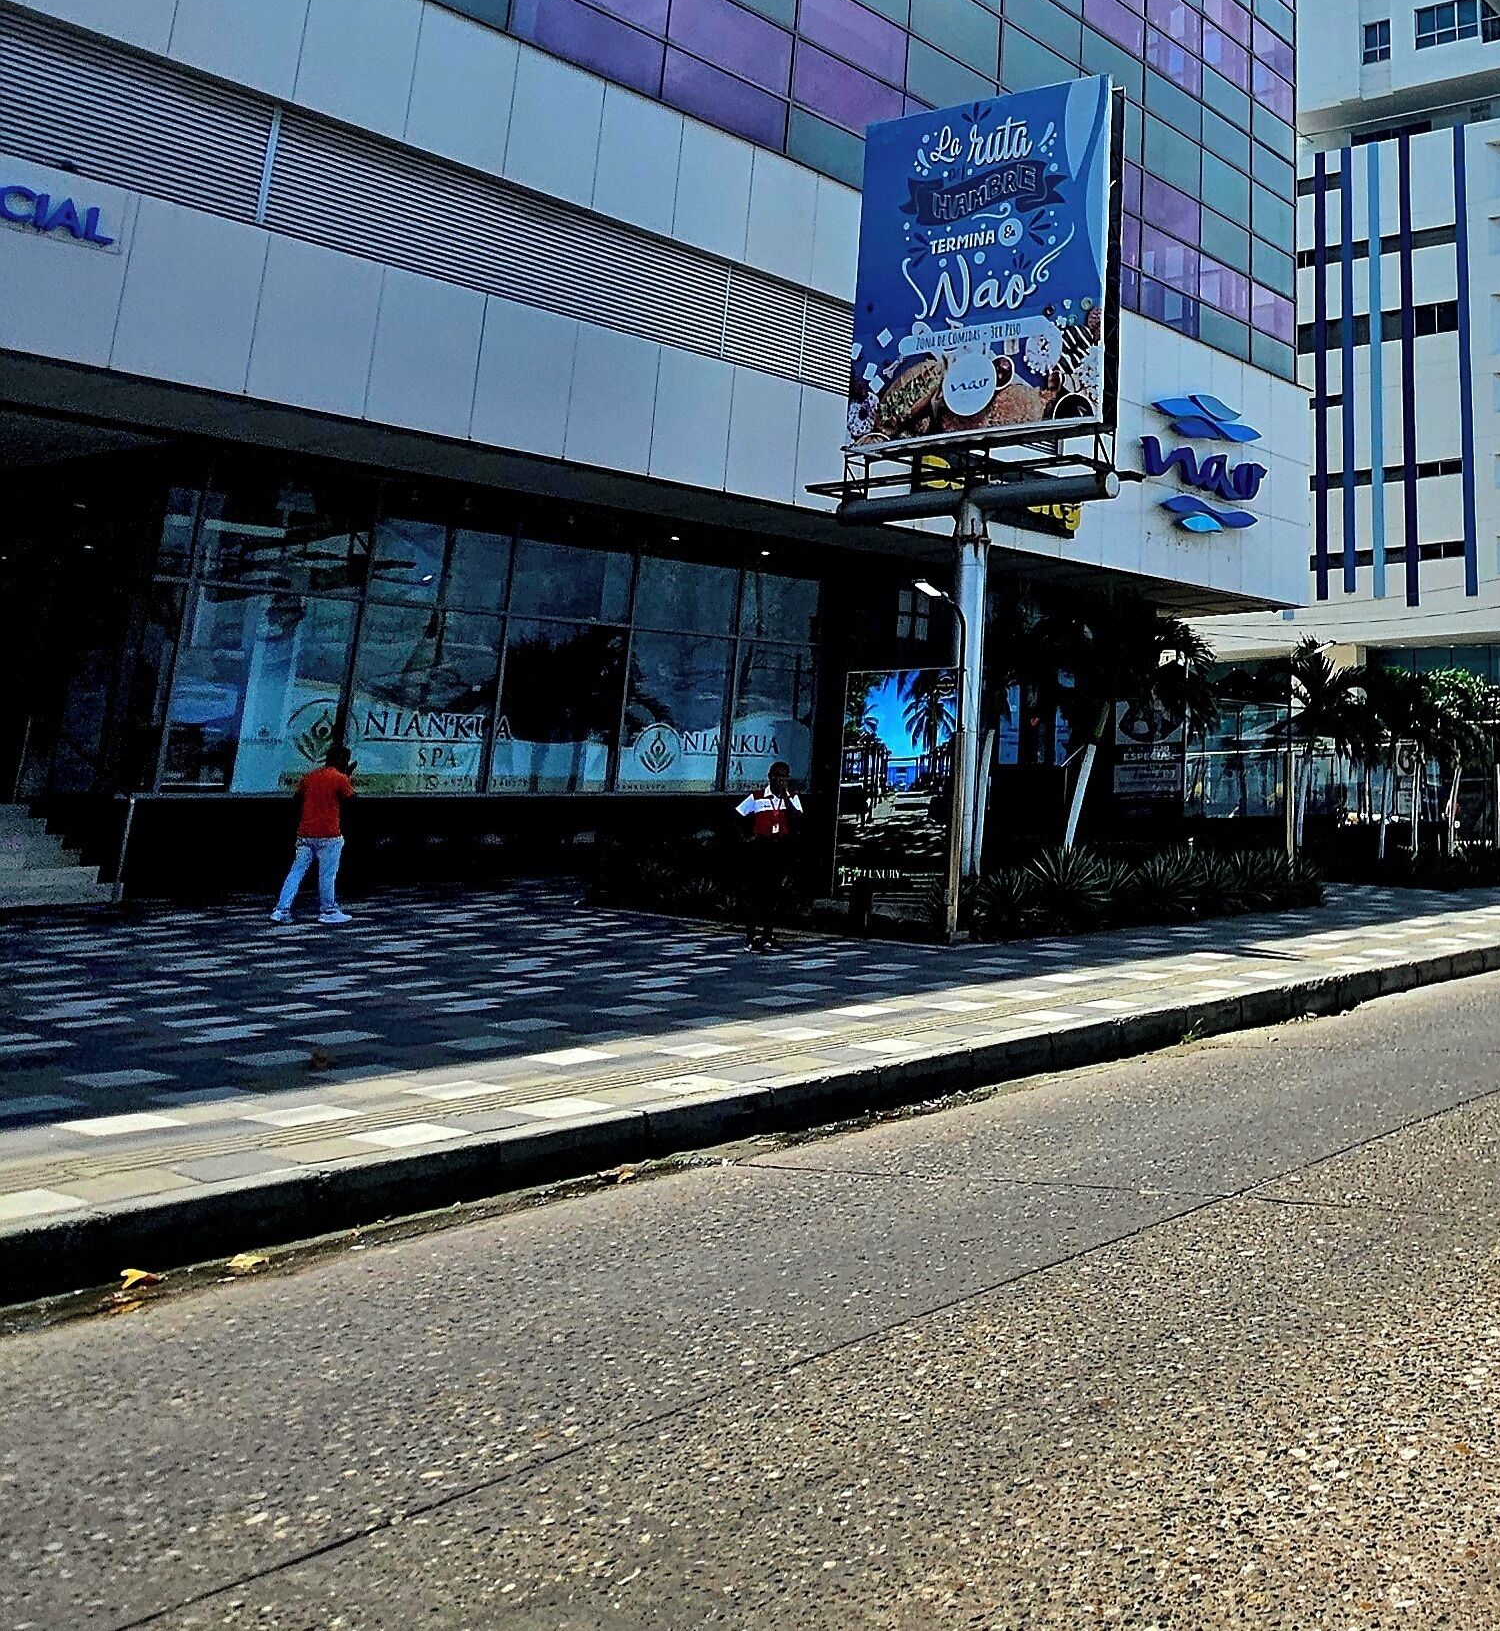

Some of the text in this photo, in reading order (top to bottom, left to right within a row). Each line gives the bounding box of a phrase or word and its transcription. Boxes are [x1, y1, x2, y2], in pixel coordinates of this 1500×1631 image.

[930, 116, 1033, 166] La ruta
[932, 163, 1037, 221] HAMBRE
[929, 229, 995, 255] TERMINA
[915, 334, 935, 351] ZONA
[937, 332, 947, 347] DE
[947, 329, 981, 346] COMIDAS
[1005, 322, 1021, 338] PISO
[1139, 435, 1269, 502] nao
[418, 746, 457, 768] SPA
